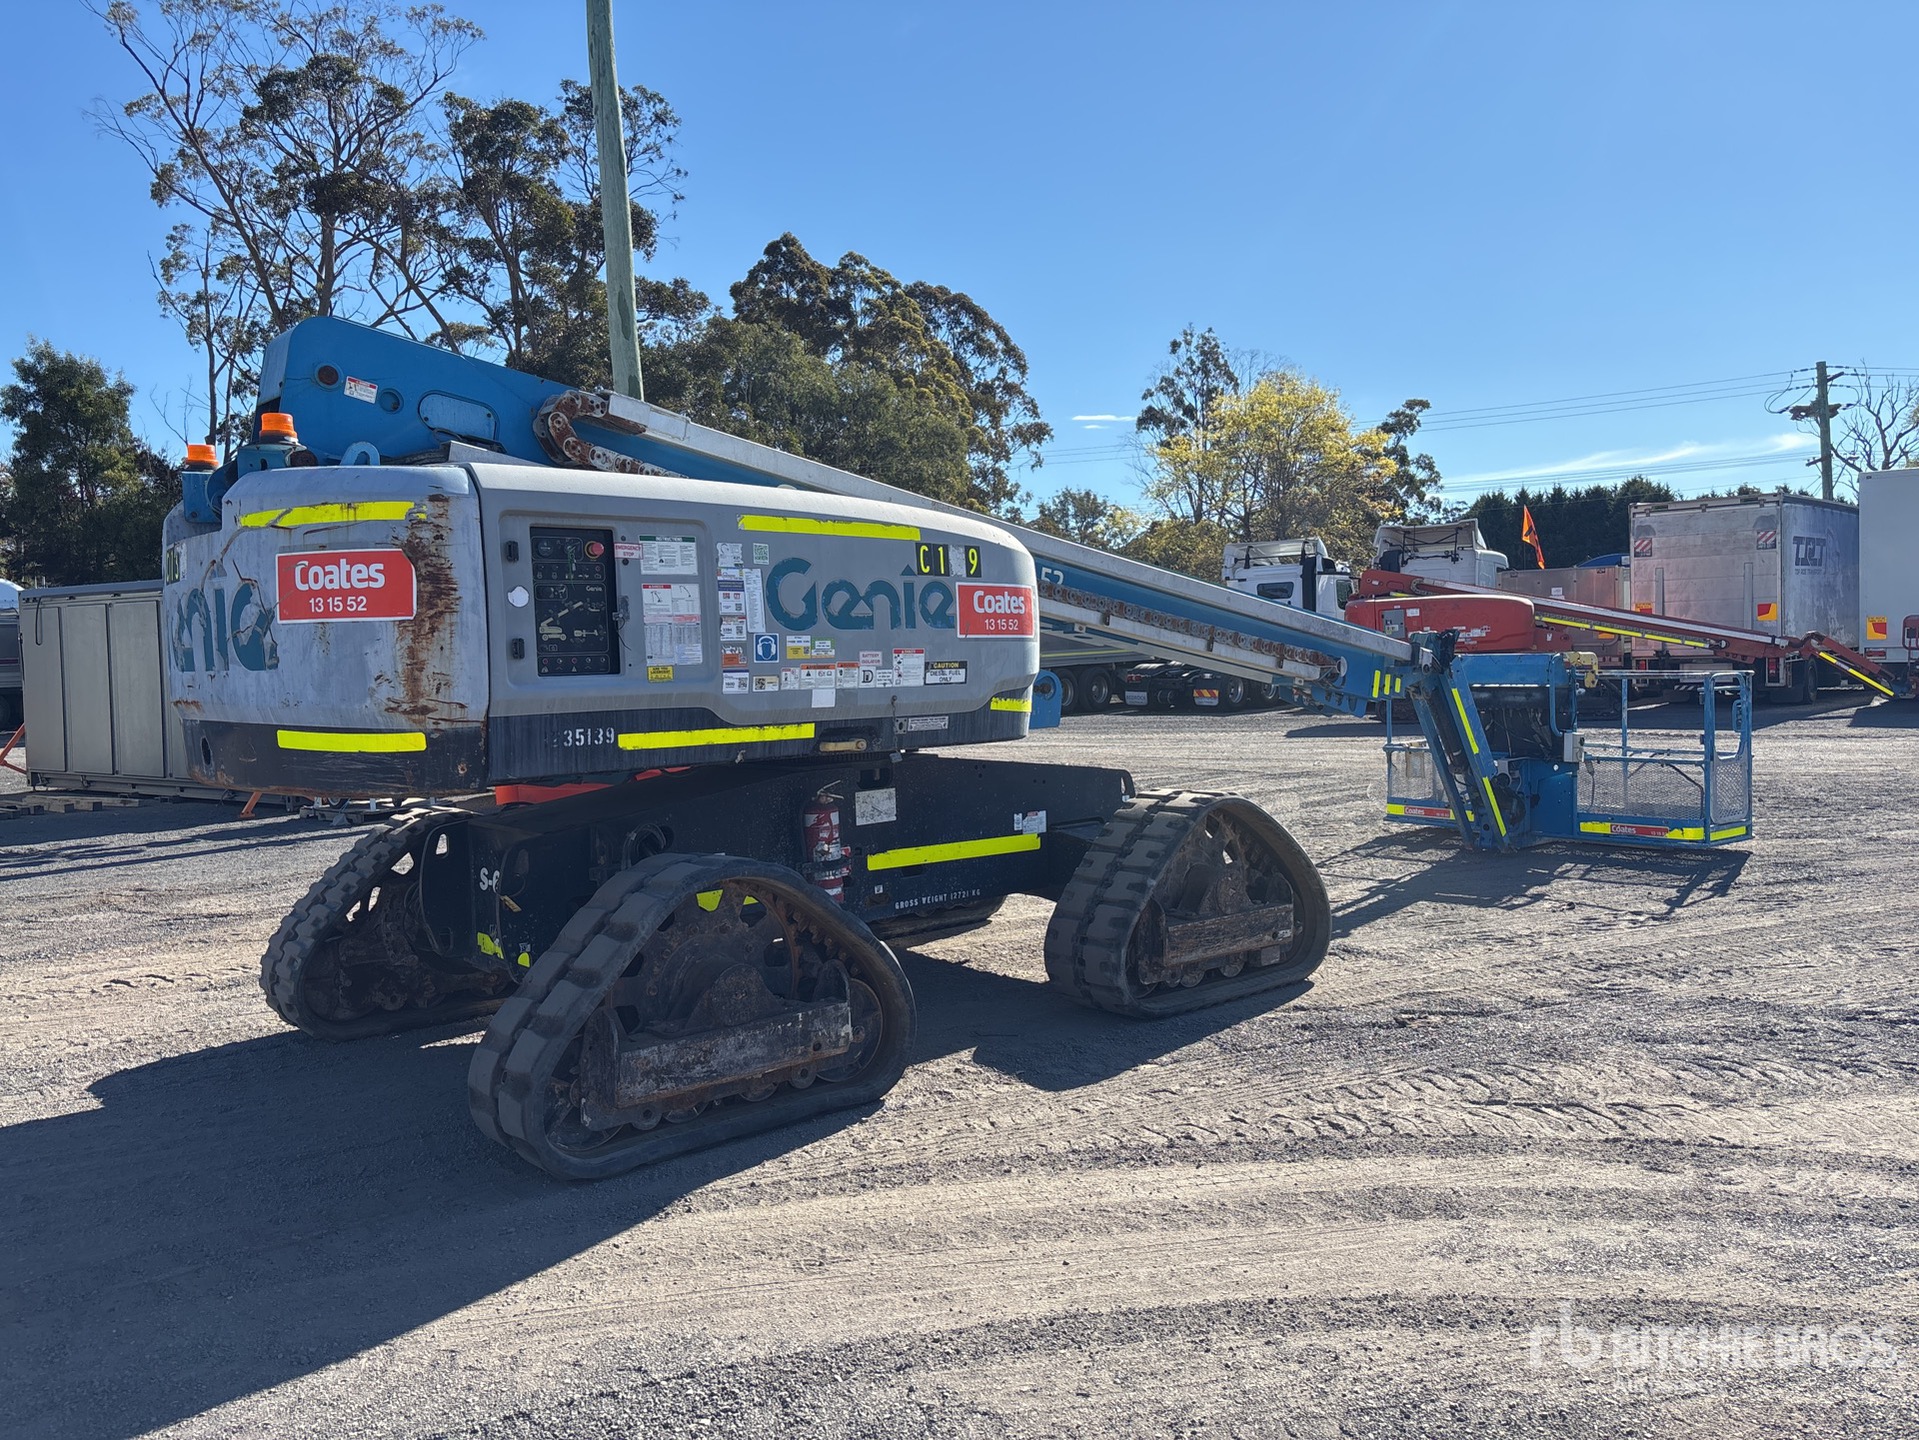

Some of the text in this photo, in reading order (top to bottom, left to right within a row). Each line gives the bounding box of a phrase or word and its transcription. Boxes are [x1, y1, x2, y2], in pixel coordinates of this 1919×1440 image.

[295, 558, 386, 592] Coates
[766, 556, 955, 631] Genie
[973, 589, 1026, 615] Coates
[309, 595, 367, 613] 13 15 52
[984, 619, 1019, 631] 13 15 52
[1405, 807, 1425, 815] Coates
[1611, 825, 1636, 834] Coates
[895, 898, 918, 909] GROSS
[922, 893, 947, 904] WEIGHT
